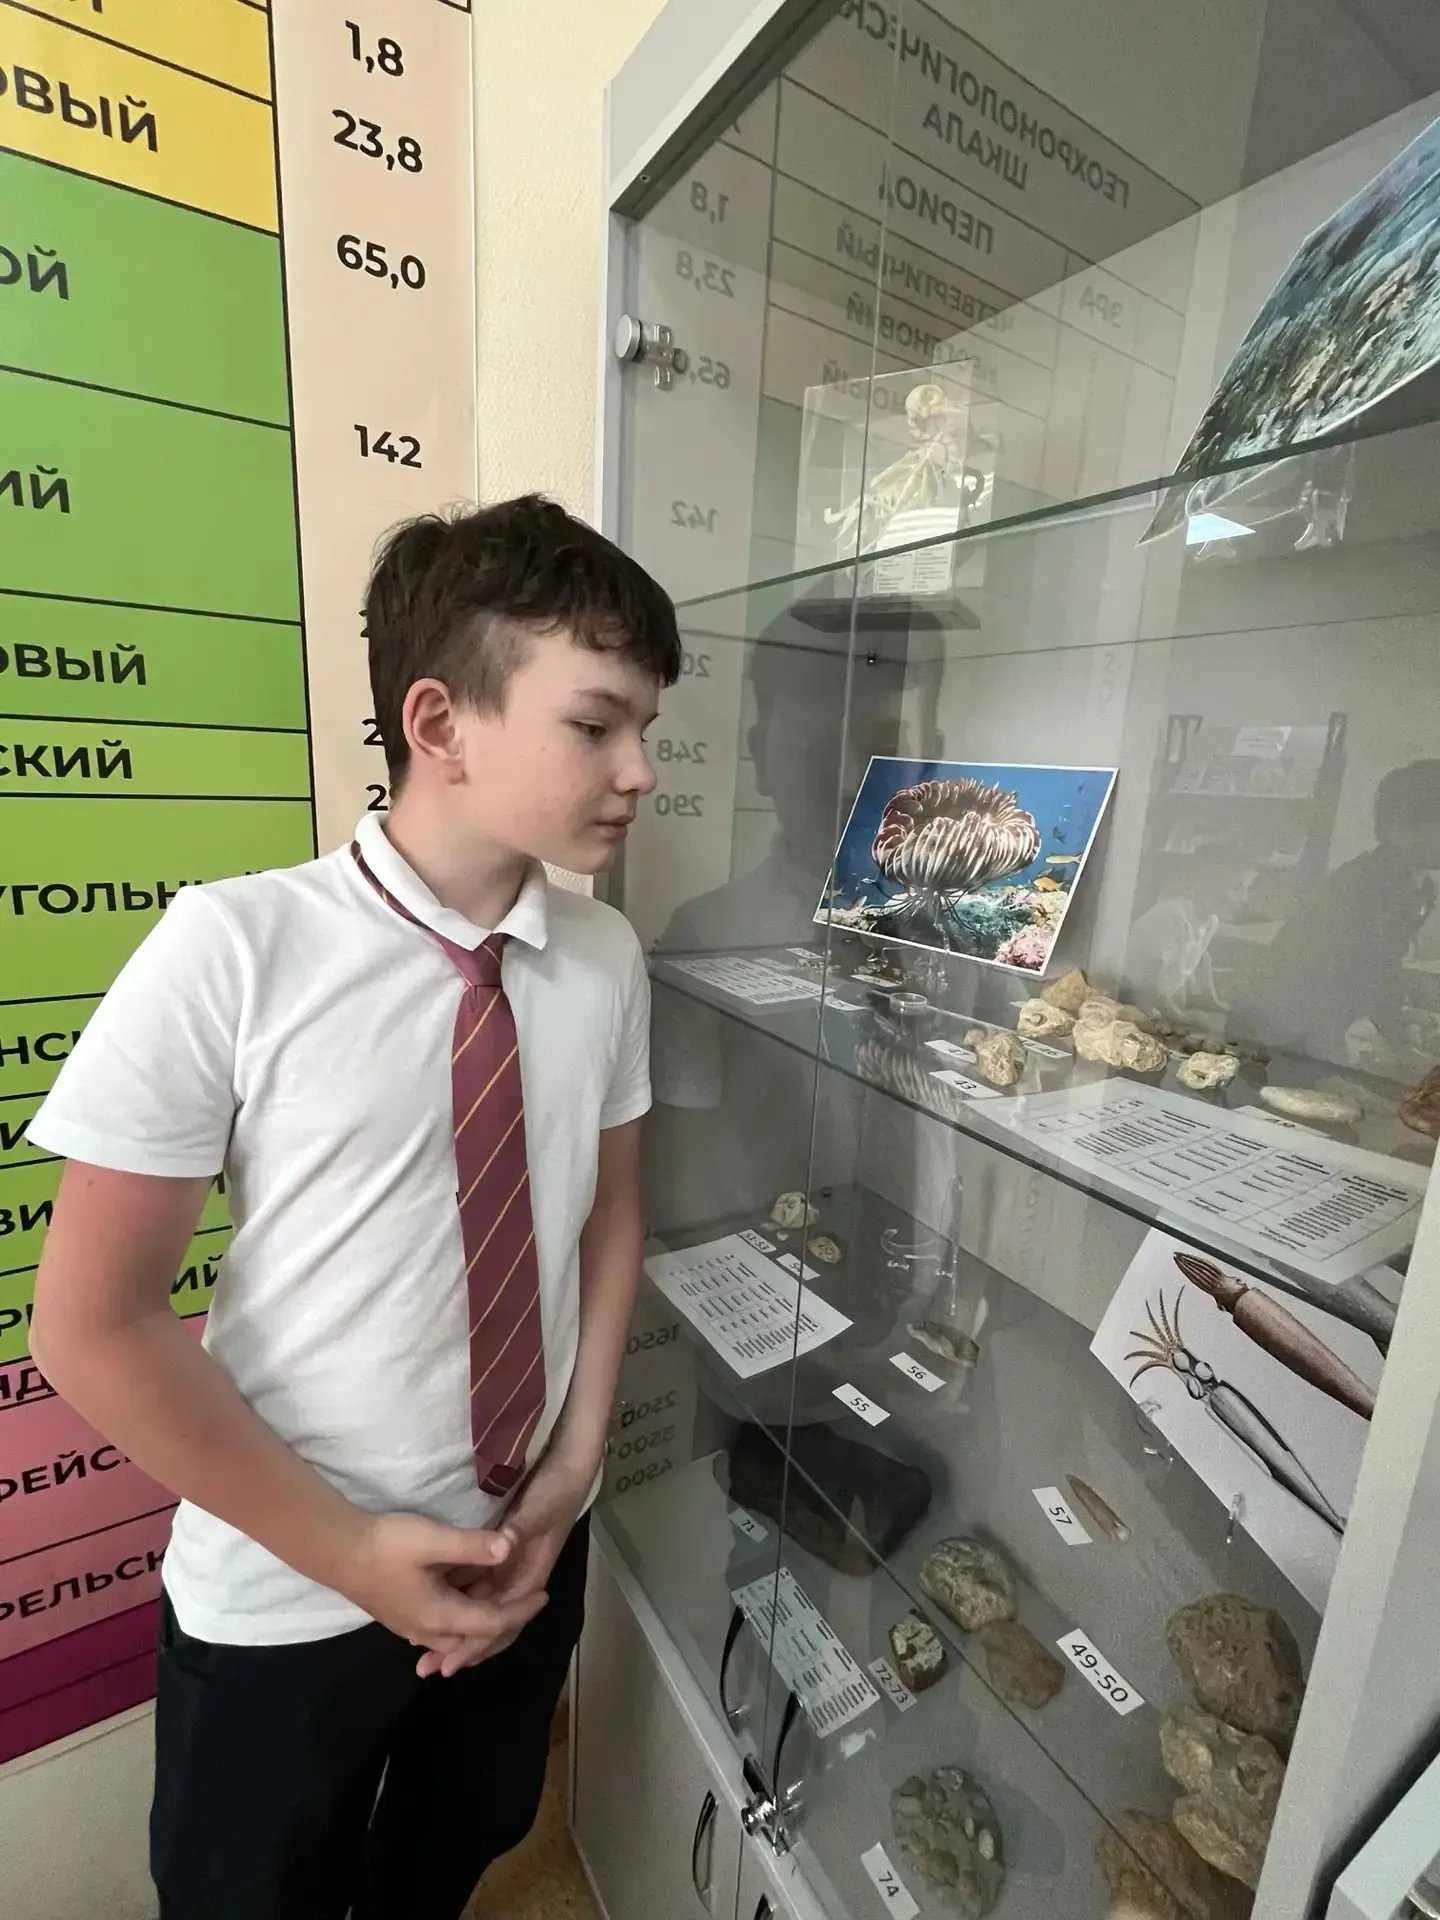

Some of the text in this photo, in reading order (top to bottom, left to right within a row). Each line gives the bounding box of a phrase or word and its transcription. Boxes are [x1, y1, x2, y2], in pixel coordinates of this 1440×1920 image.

[345, 20, 404, 77] 1,8
[0, 65, 159, 153] ВЫЙ
[332, 109, 424, 173] 23,8
[337, 234, 427, 290] 65,0
[354, 424, 423, 468] 142
[0, 642, 147, 686] ВЫЙ
[953, 1079, 977, 1090] 43
[906, 1365, 927, 1380] 56
[849, 1397, 871, 1412] 55
[1049, 1506, 1073, 1526] 57
[875, 1664, 908, 1703] 72-73
[1071, 1644, 1129, 1703] 49-50
[878, 1870, 900, 1898] 74
